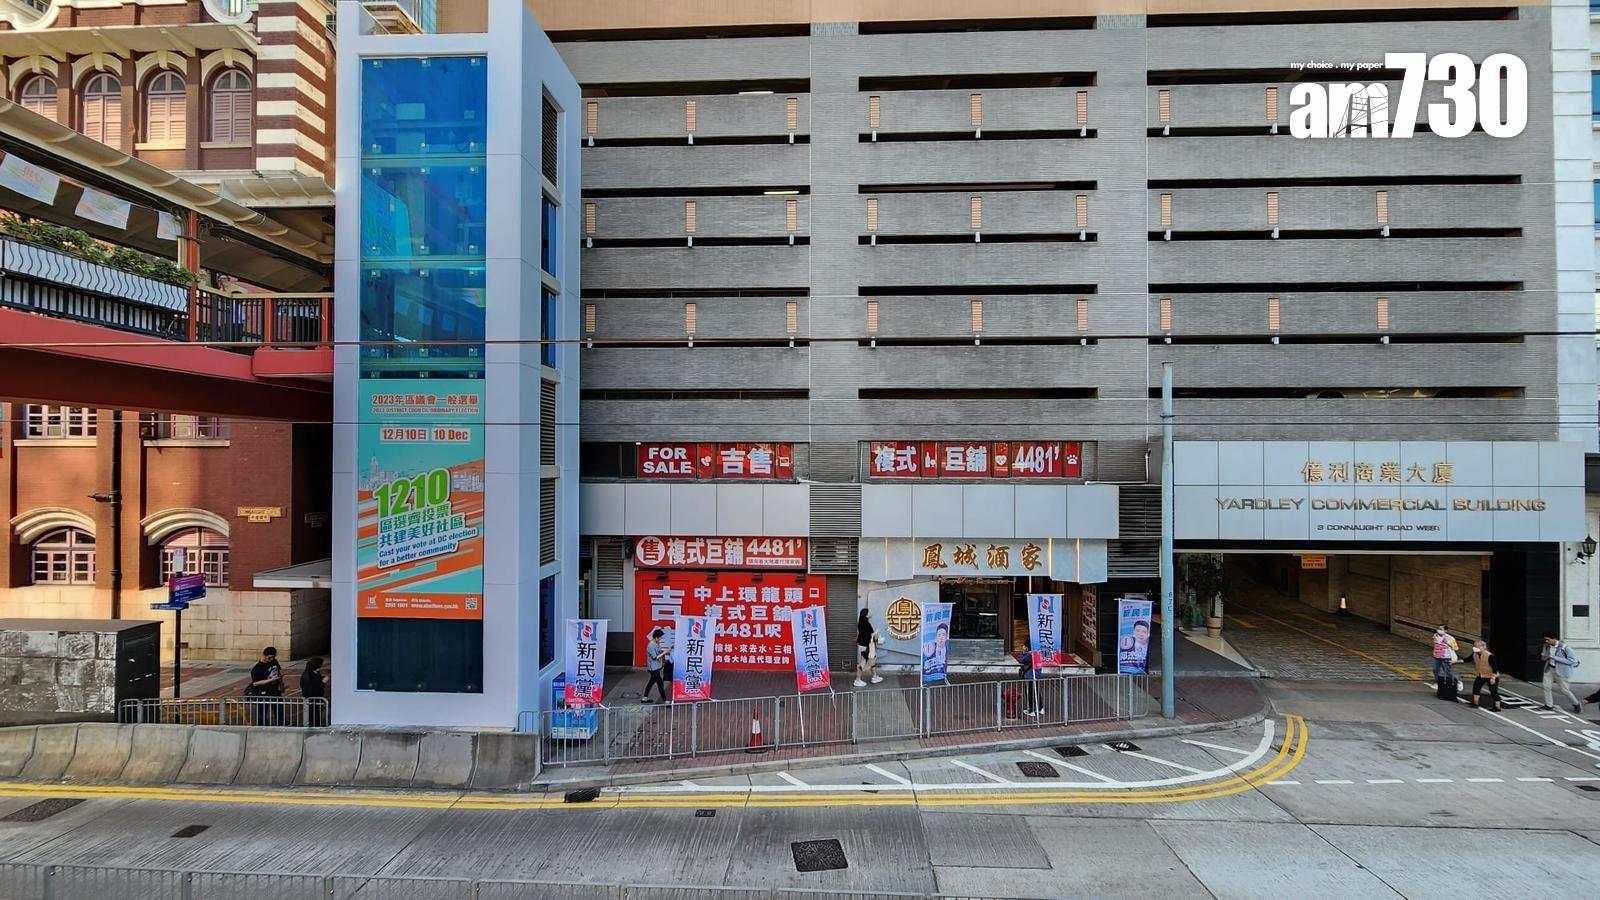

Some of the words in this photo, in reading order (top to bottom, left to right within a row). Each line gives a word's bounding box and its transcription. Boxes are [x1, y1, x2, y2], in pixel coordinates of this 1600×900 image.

[382, 429, 426, 440] 12月10日
[434, 429, 445, 440] 10
[448, 429, 468, 440] Dec
[648, 447, 687, 460] FOR
[720, 448, 773, 474] 吉售
[875, 445, 917, 473] 複式
[945, 446, 987, 472] 巨舖
[643, 461, 692, 474] SALE
[1302, 462, 1455, 483] 億利商業大廈
[374, 468, 450, 518] 1210
[1216, 498, 1304, 511] YARDLEY
[1311, 498, 1446, 512] COMMERCIAL
[1453, 499, 1546, 512] BUILDING
[380, 504, 449, 533] 區選齊投票
[380, 514, 463, 547] 共建美好社區
[380, 548, 394, 558] Cast
[396, 545, 411, 554] your
[449, 529, 476, 540] election
[397, 552, 416, 562] better
[418, 542, 456, 558] community
[667, 537, 744, 566] 複式巨舖
[922, 543, 1042, 571] 鳳城酒家
[694, 586, 803, 603] 中上環龍頭
[714, 623, 782, 638] 4481呎
[575, 642, 596, 698] 新民黨
[684, 638, 705, 694] 新民黨
[802, 629, 823, 684] 新民黨
